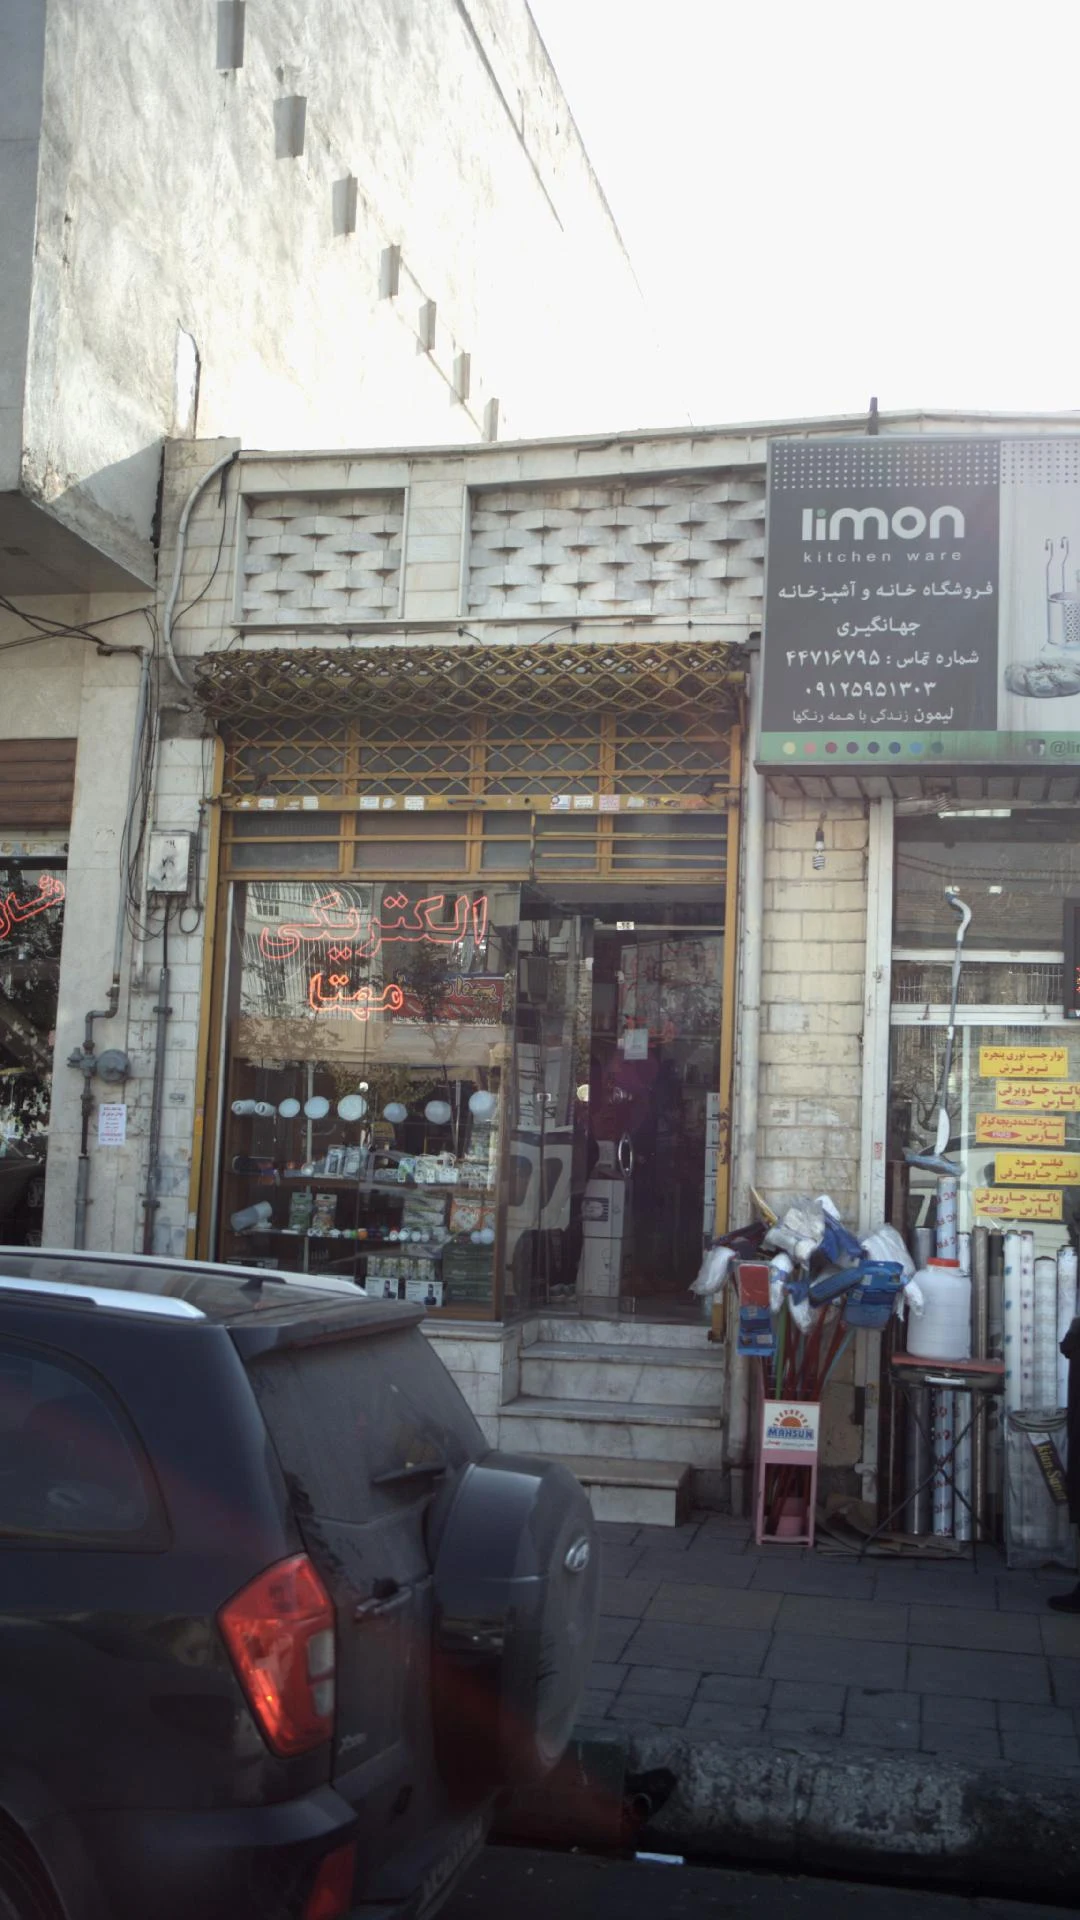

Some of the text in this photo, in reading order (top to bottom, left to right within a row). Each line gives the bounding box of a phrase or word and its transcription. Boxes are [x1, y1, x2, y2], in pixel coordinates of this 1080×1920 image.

[802, 505, 965, 541] limon
[803, 551, 962, 563] kitchen ware
[778, 580, 994, 604] فروشگاه خانه و آشپزخانه
[836, 615, 921, 637] جهانگیری
[786, 649, 880, 667] ۴۴۷۱۶۷۹۵
[896, 651, 930, 668] تماس
[935, 649, 980, 667] شماره
[806, 681, 937, 697] ۰۹۱۲۵۹۵۱۳۰۳
[827, 711, 855, 722] همه
[858, 709, 867, 723] با
[869, 708, 909, 724] زندگی
[913, 706, 954, 724] لیمون
[259, 890, 488, 960] الکتریکی
